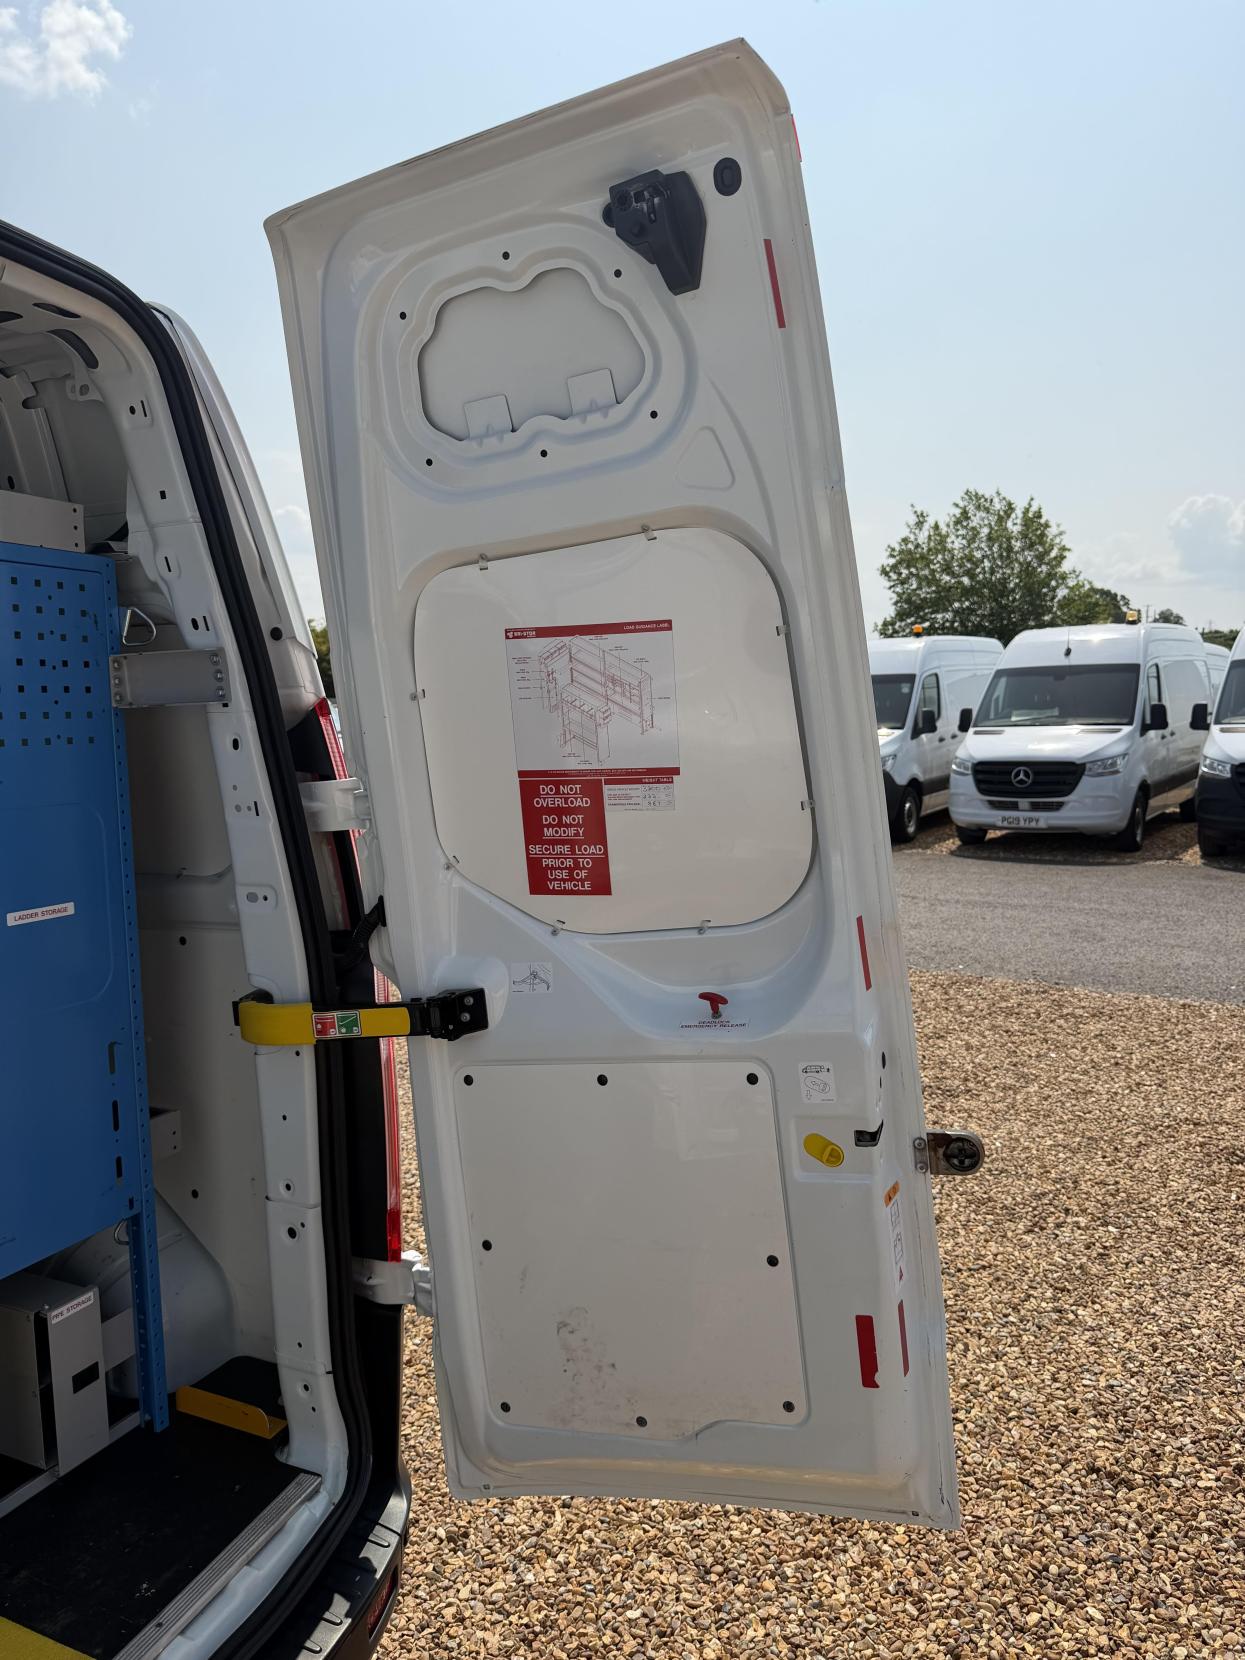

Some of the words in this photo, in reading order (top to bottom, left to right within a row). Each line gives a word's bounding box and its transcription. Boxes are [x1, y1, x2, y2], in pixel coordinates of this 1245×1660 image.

[540, 785, 556, 795] DO
[560, 784, 582, 794] NOT
[533, 797, 591, 808] OVERLOAD
[542, 815, 558, 824] DO
[562, 815, 584, 824] NOT
[1001, 815, 1020, 825] PG19
[1022, 815, 1040, 825] YPY
[543, 827, 585, 837] MODIFY
[528, 845, 572, 855] SECURE
[575, 845, 604, 854] LOAD
[542, 858, 574, 868] PRIOR
[578, 858, 592, 868] TO
[548, 870, 570, 879] USE
[573, 870, 589, 879] OF
[547, 881, 592, 890] VEHICLE
[14, 911, 39, 922] LADDER
[40, 906, 69, 917] STORAGE
[65, 1295, 92, 1313] STORAGE
